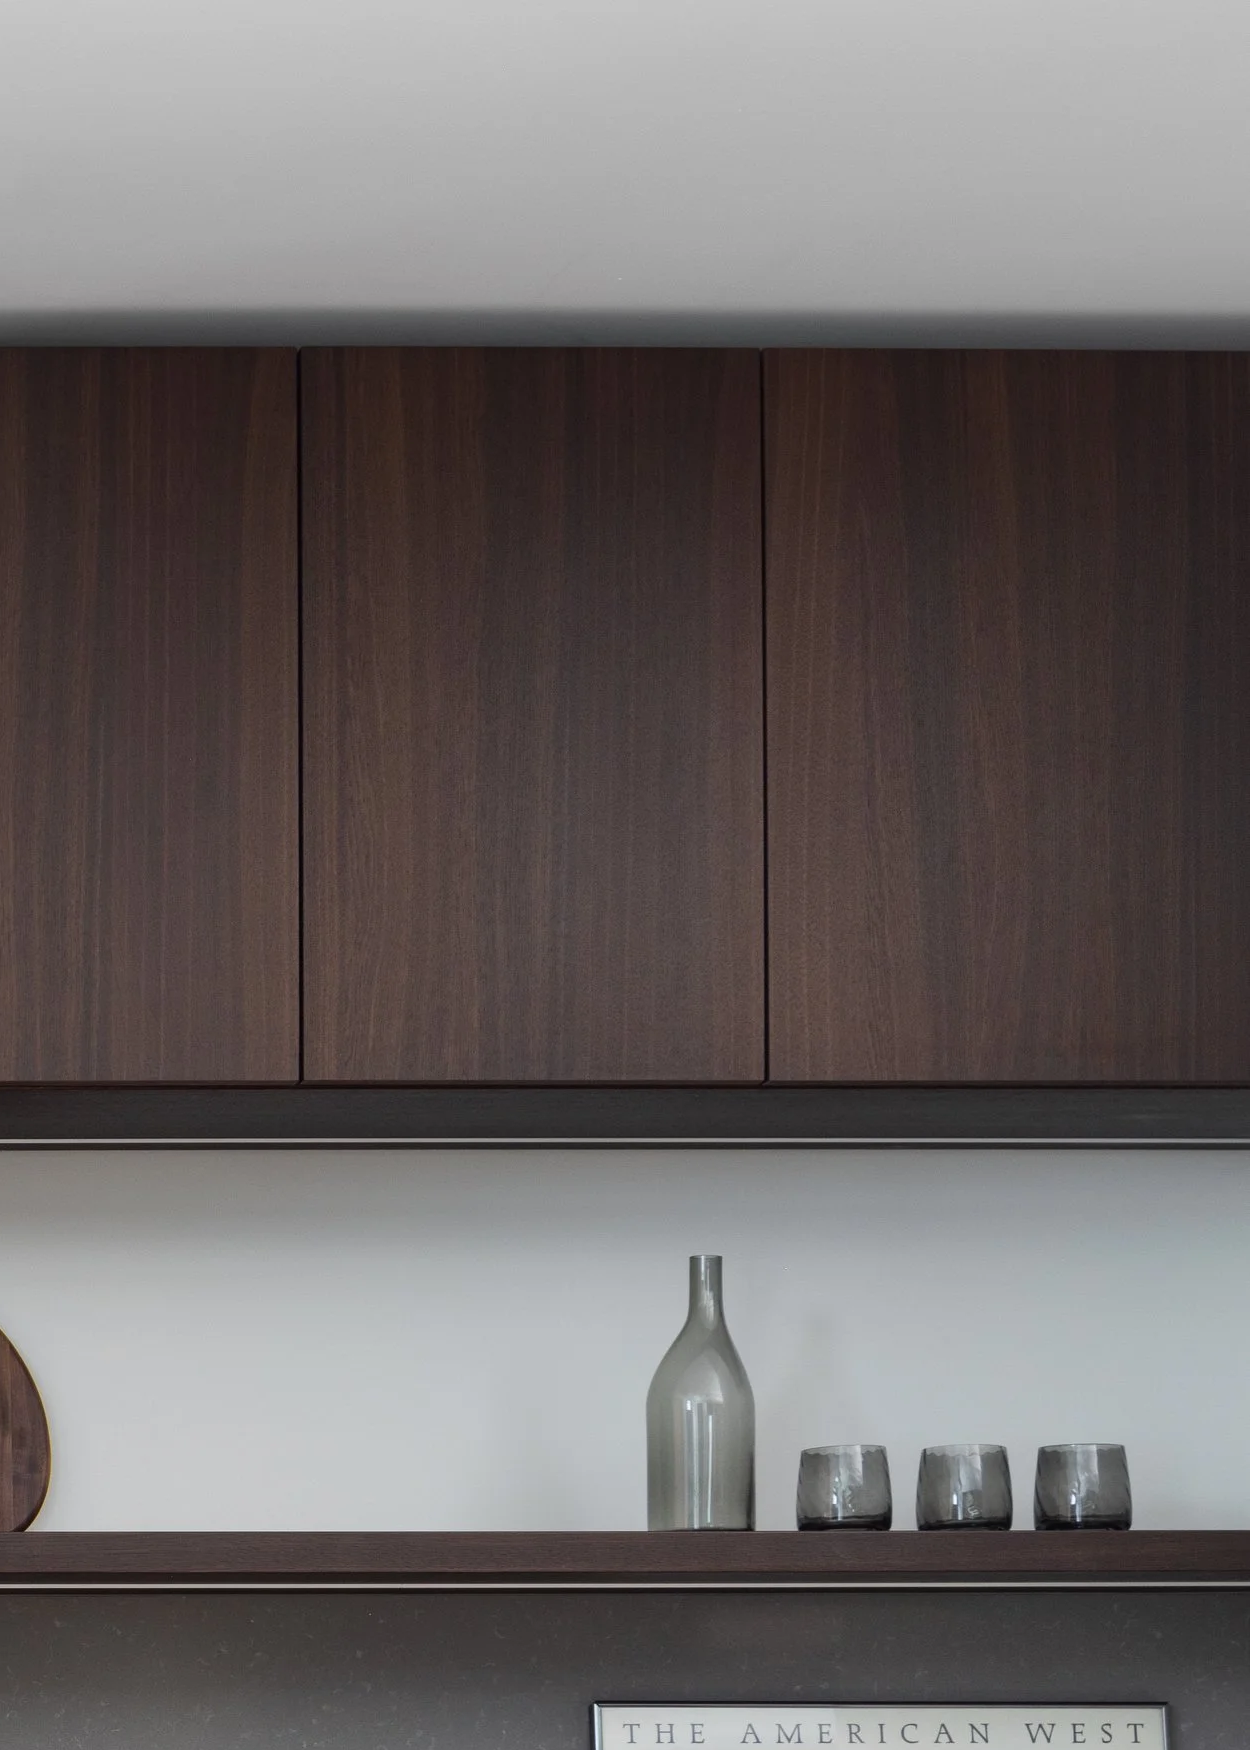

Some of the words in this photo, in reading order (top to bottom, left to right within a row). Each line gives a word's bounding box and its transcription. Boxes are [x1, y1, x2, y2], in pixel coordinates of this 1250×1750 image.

[622, 1723, 705, 1744] THE
[739, 1723, 990, 1744] AMERICAN
[1025, 1723, 1145, 1744] WEST
